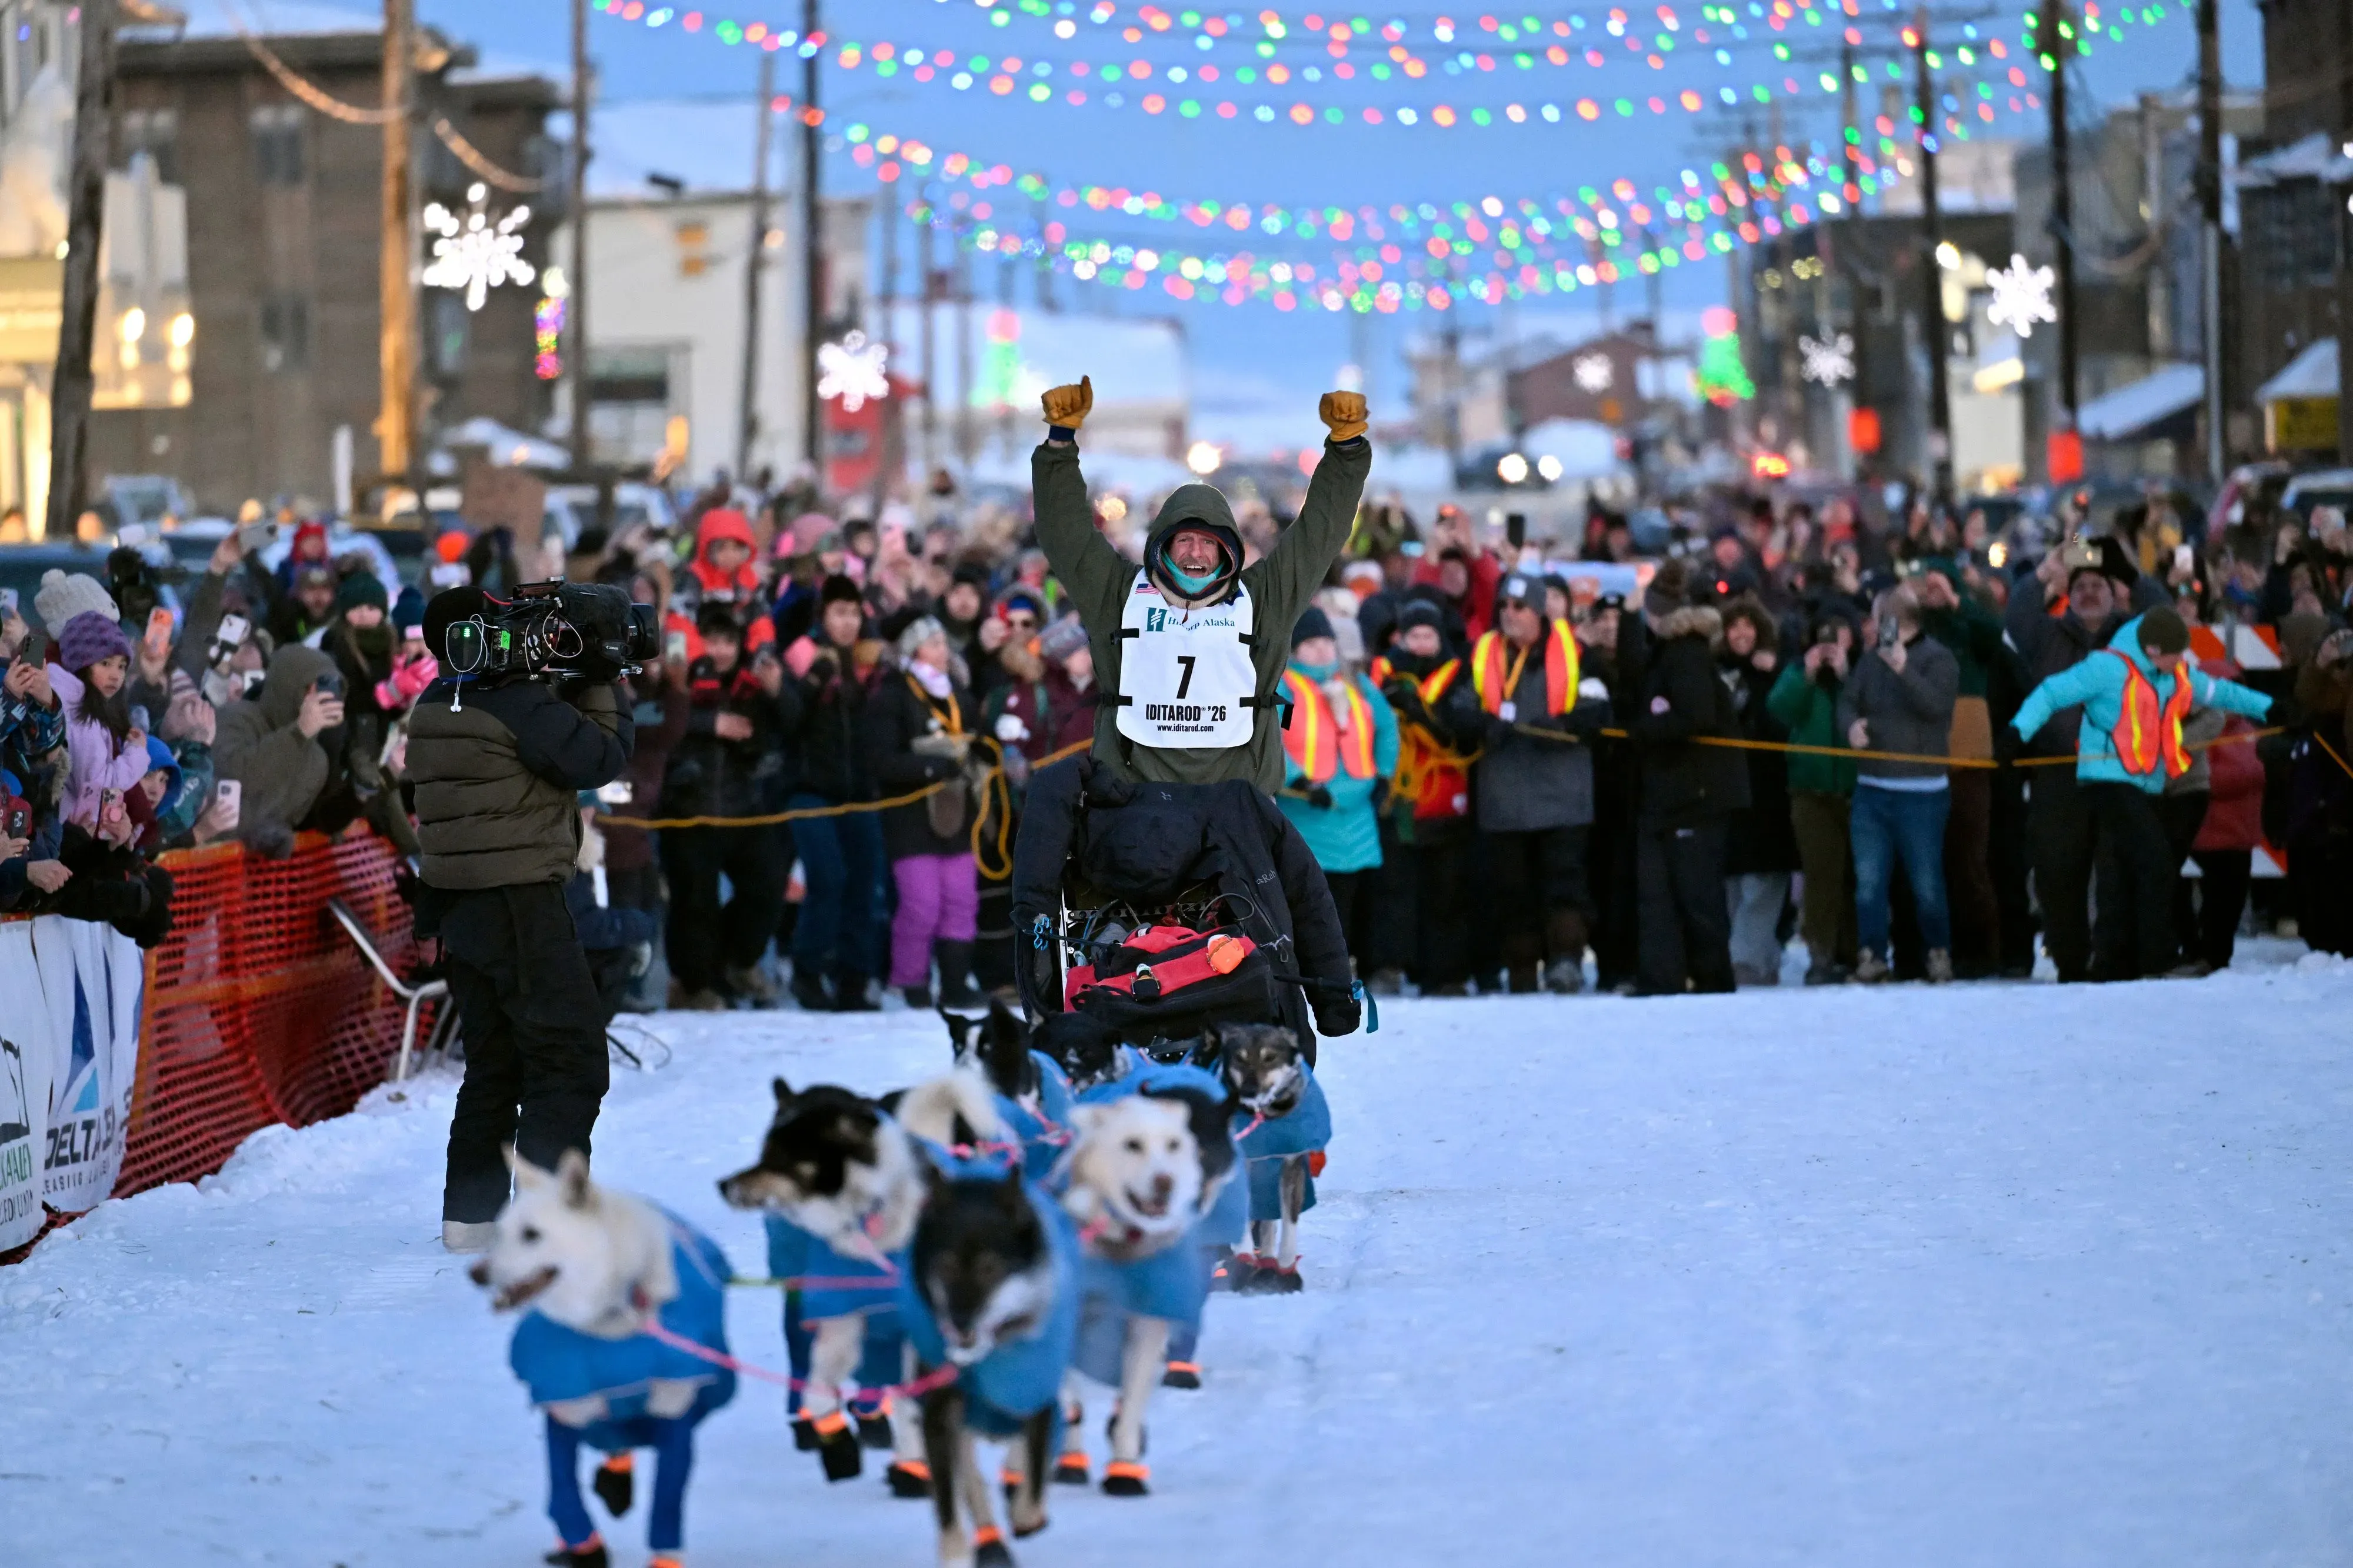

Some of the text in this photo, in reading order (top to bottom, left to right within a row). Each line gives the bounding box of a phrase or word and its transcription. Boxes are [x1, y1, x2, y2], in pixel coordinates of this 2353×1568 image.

[1168, 616, 1235, 631] Hiorp Alaska
[1176, 656, 1196, 699] 7
[1208, 705, 1227, 722] '26
[1157, 724, 1214, 732] www.iditarod.com
[1262, 870, 1276, 883] Rab
[42, 1171, 82, 1195] EASIG
